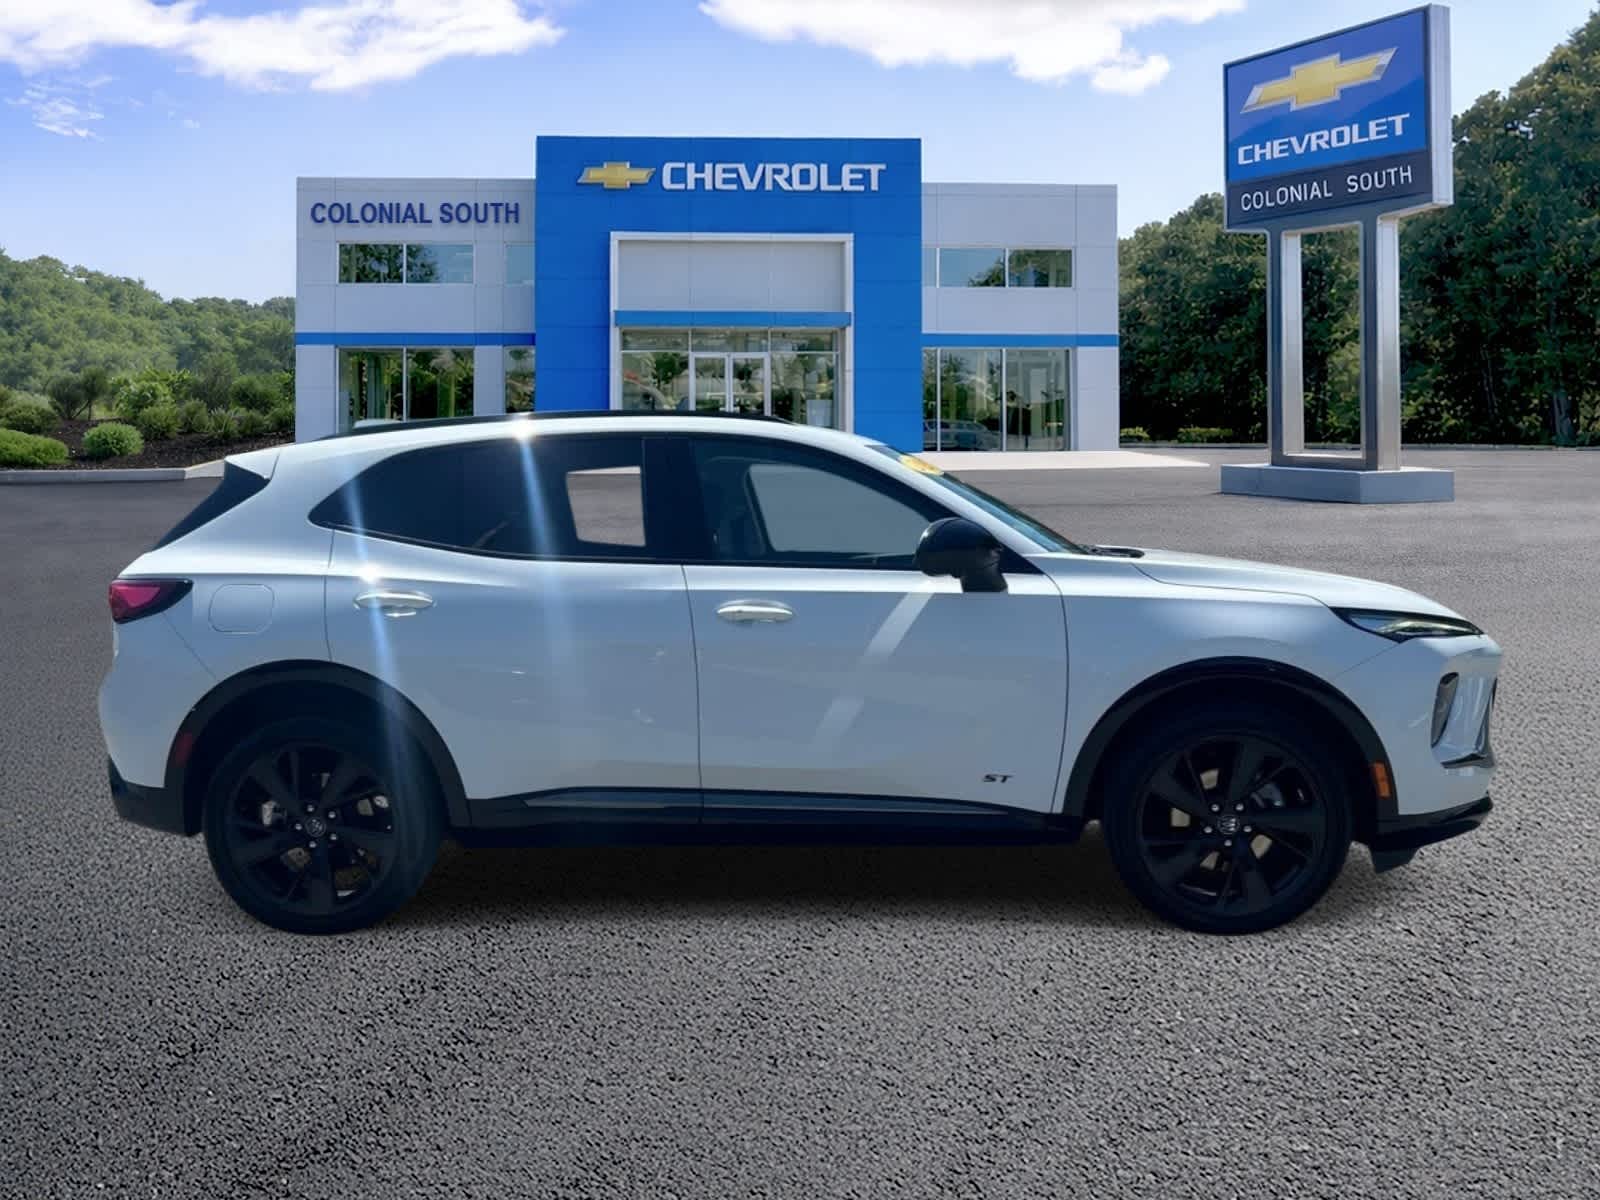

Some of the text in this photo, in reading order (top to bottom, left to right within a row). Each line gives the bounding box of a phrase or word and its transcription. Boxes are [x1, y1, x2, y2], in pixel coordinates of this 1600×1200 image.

[1238, 113, 1410, 166] CHEVROLET
[662, 161, 887, 192] CHEVROLET
[1241, 165, 1413, 211] COLONIAL SOUTH
[310, 202, 520, 225] COLONIAL SOUTH
[983, 773, 1014, 783] ST
